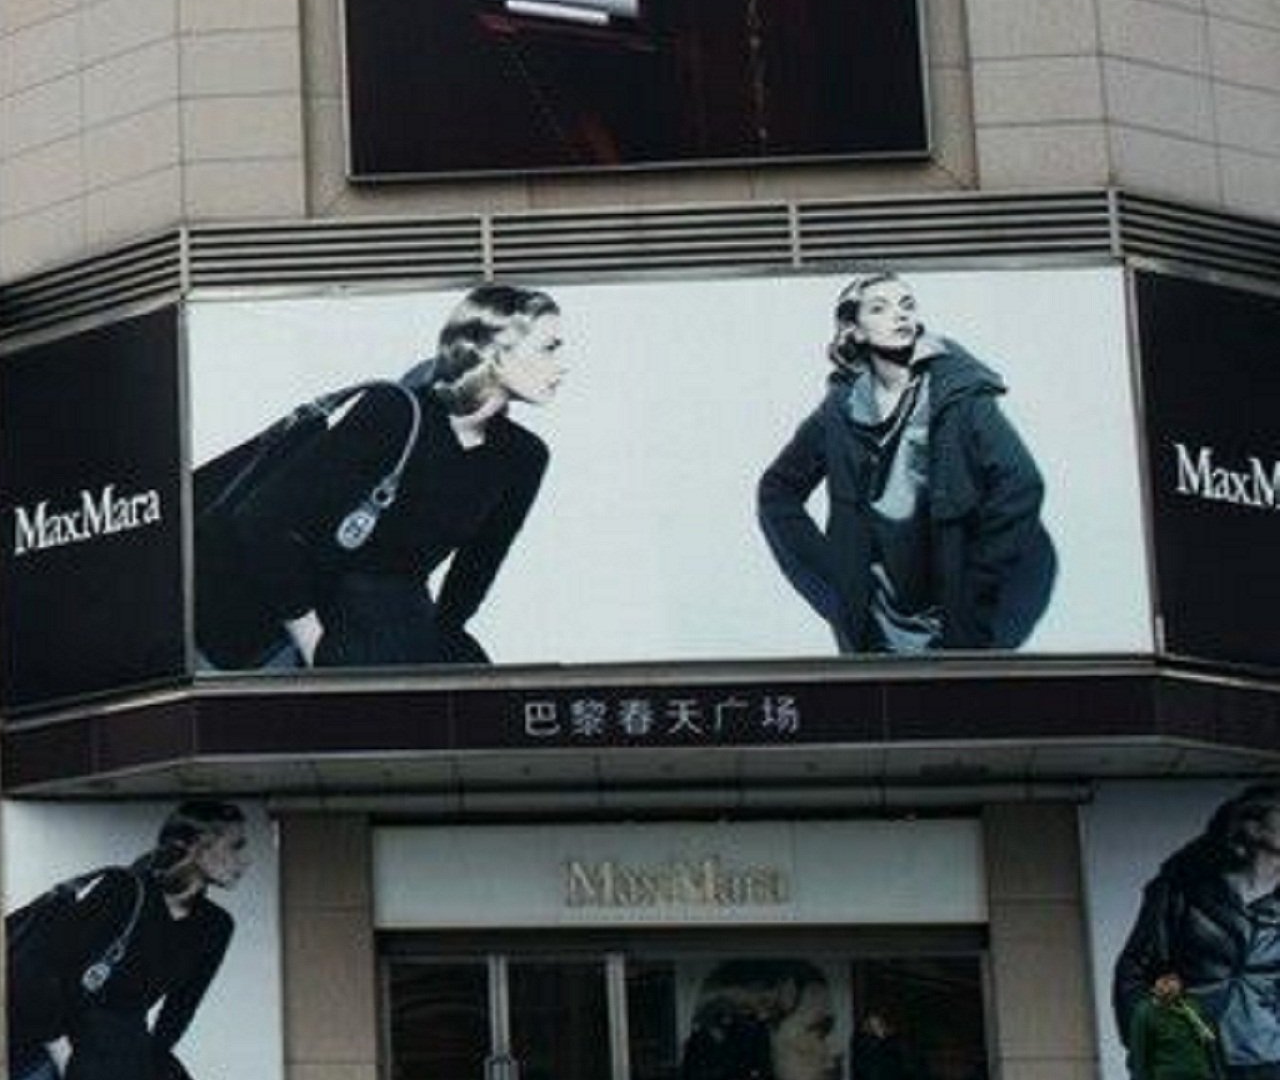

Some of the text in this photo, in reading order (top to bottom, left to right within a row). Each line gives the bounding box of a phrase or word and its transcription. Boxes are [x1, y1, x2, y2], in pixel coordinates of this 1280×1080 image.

[13, 483, 161, 556] MaxMara
[524, 695, 801, 737] 巴黎春天广场
